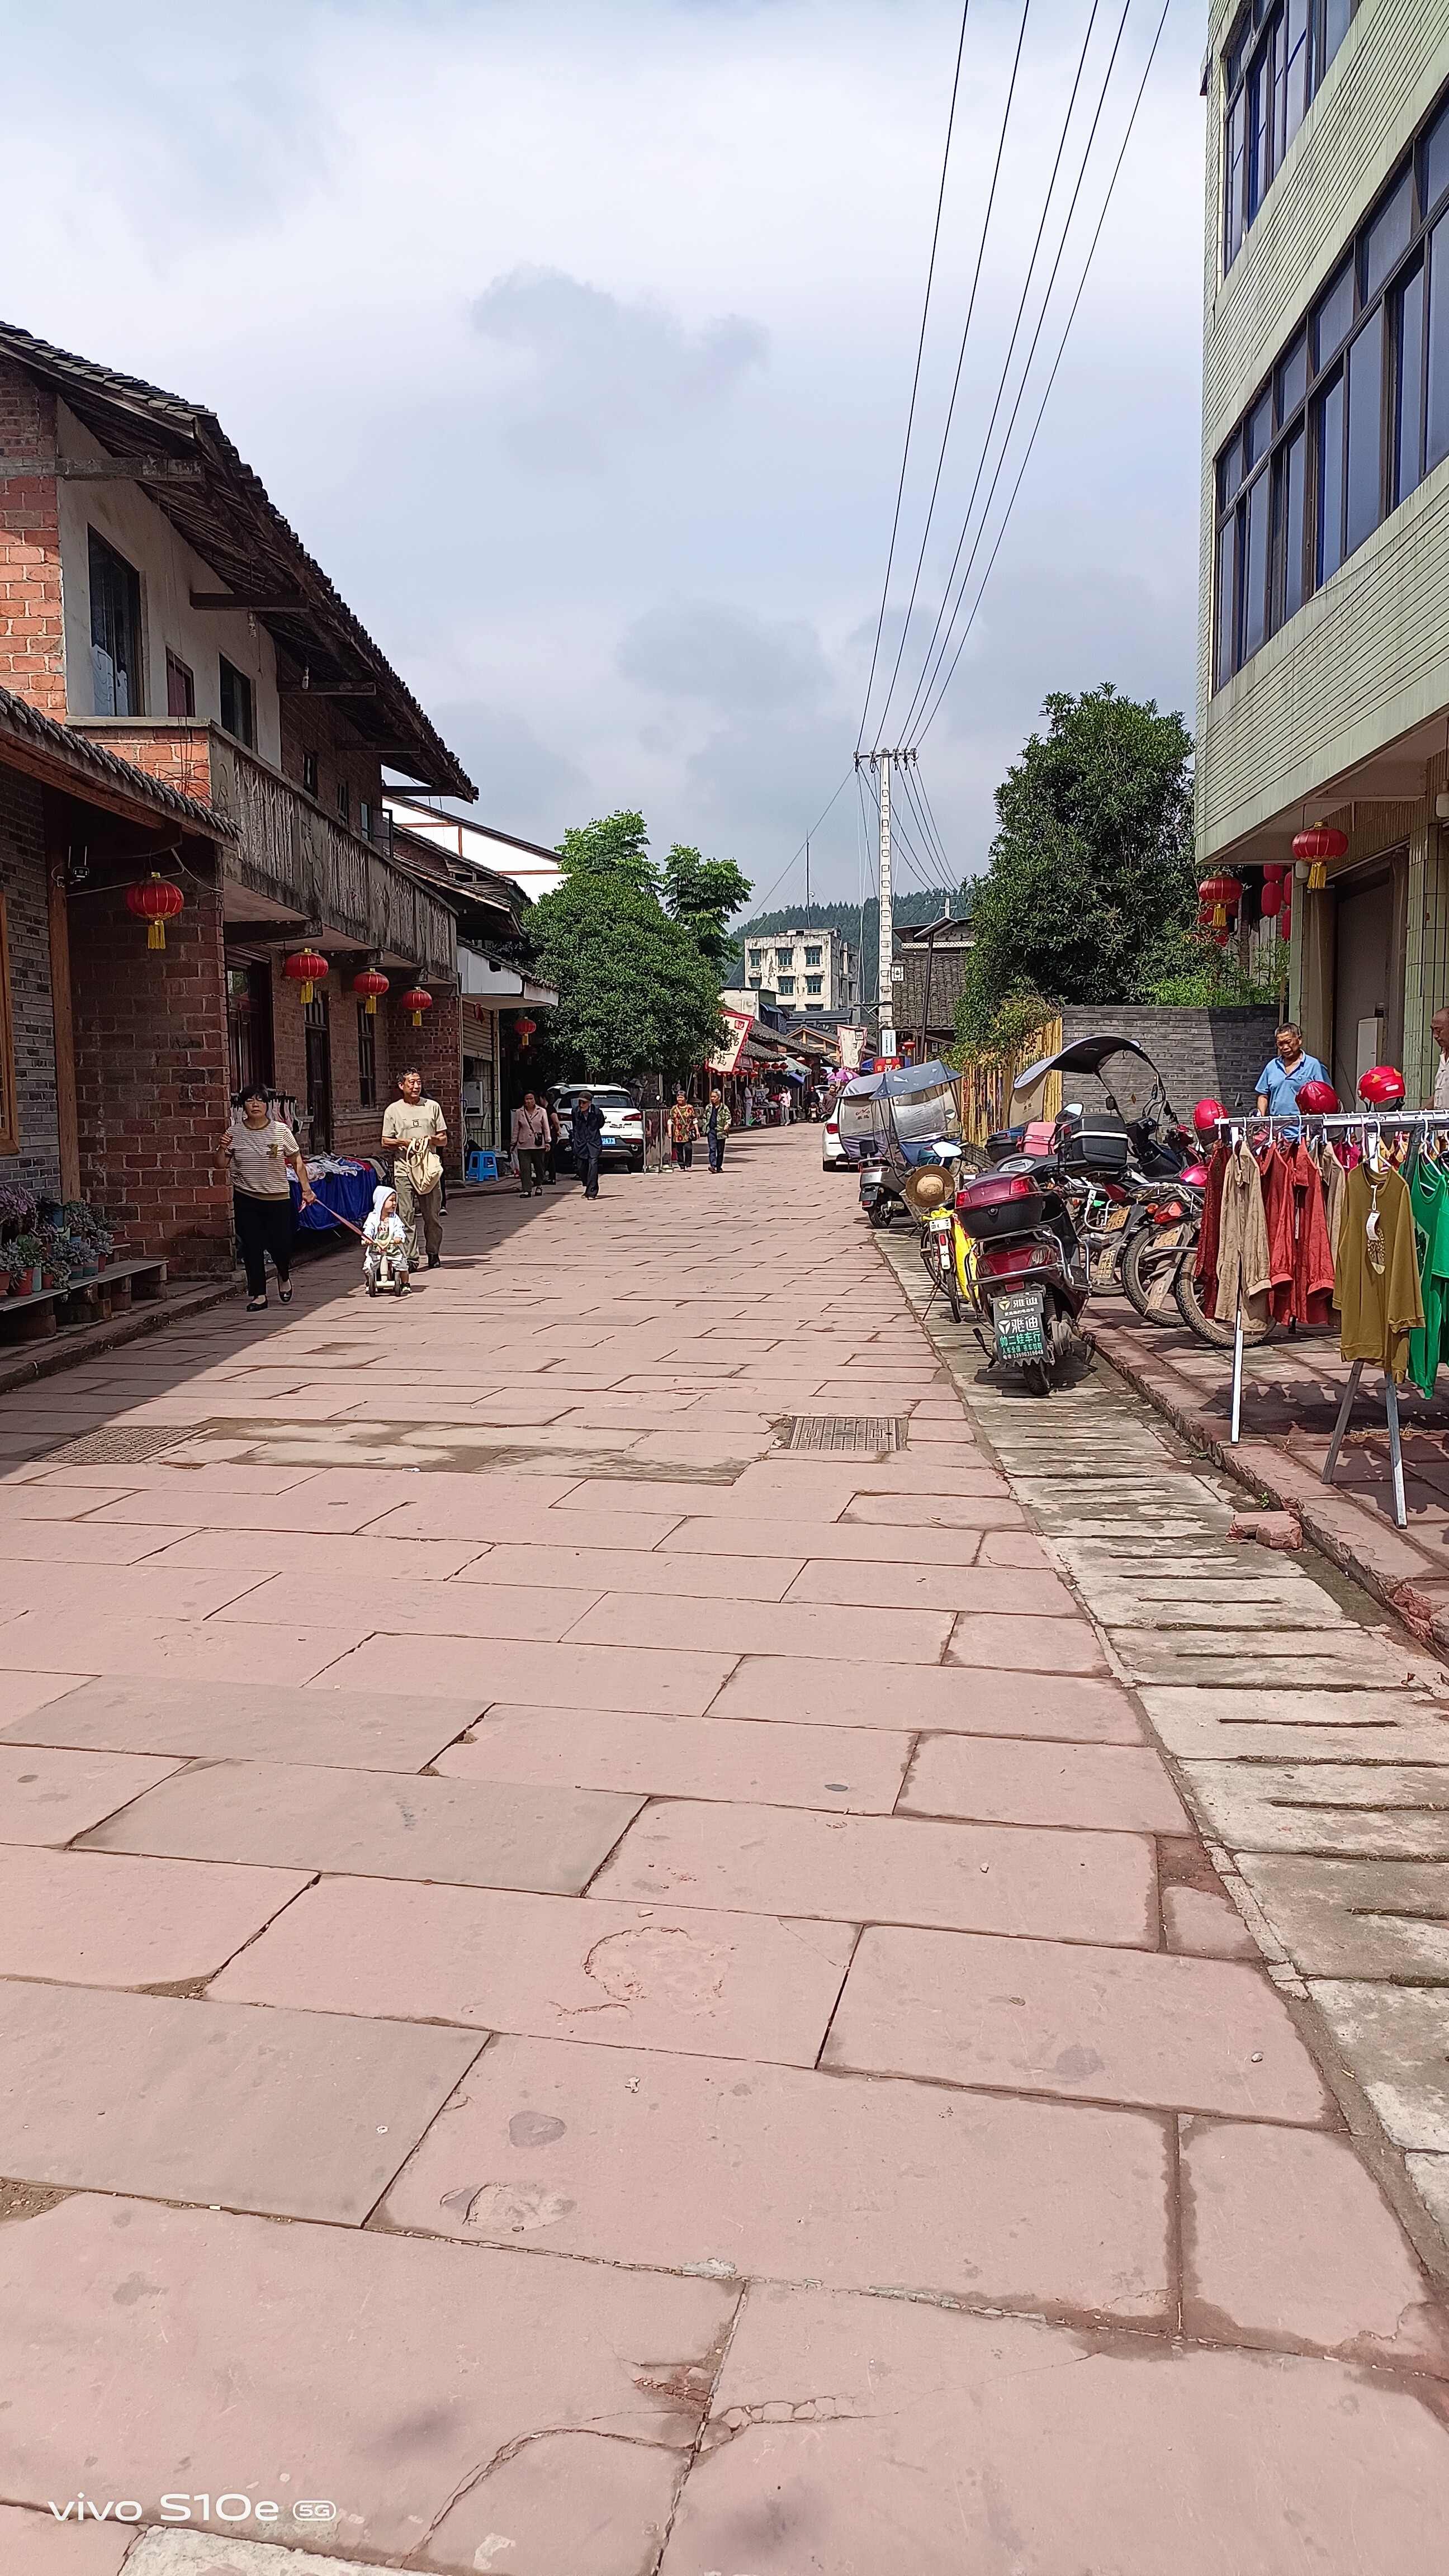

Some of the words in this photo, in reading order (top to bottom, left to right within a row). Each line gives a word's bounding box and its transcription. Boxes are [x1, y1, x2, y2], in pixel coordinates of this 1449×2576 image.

[1013, 1296, 1039, 1308] 雅迪
[1011, 1315, 1040, 1334] 雅迪
[1000, 1330, 1041, 1348] 帅二娃车行
